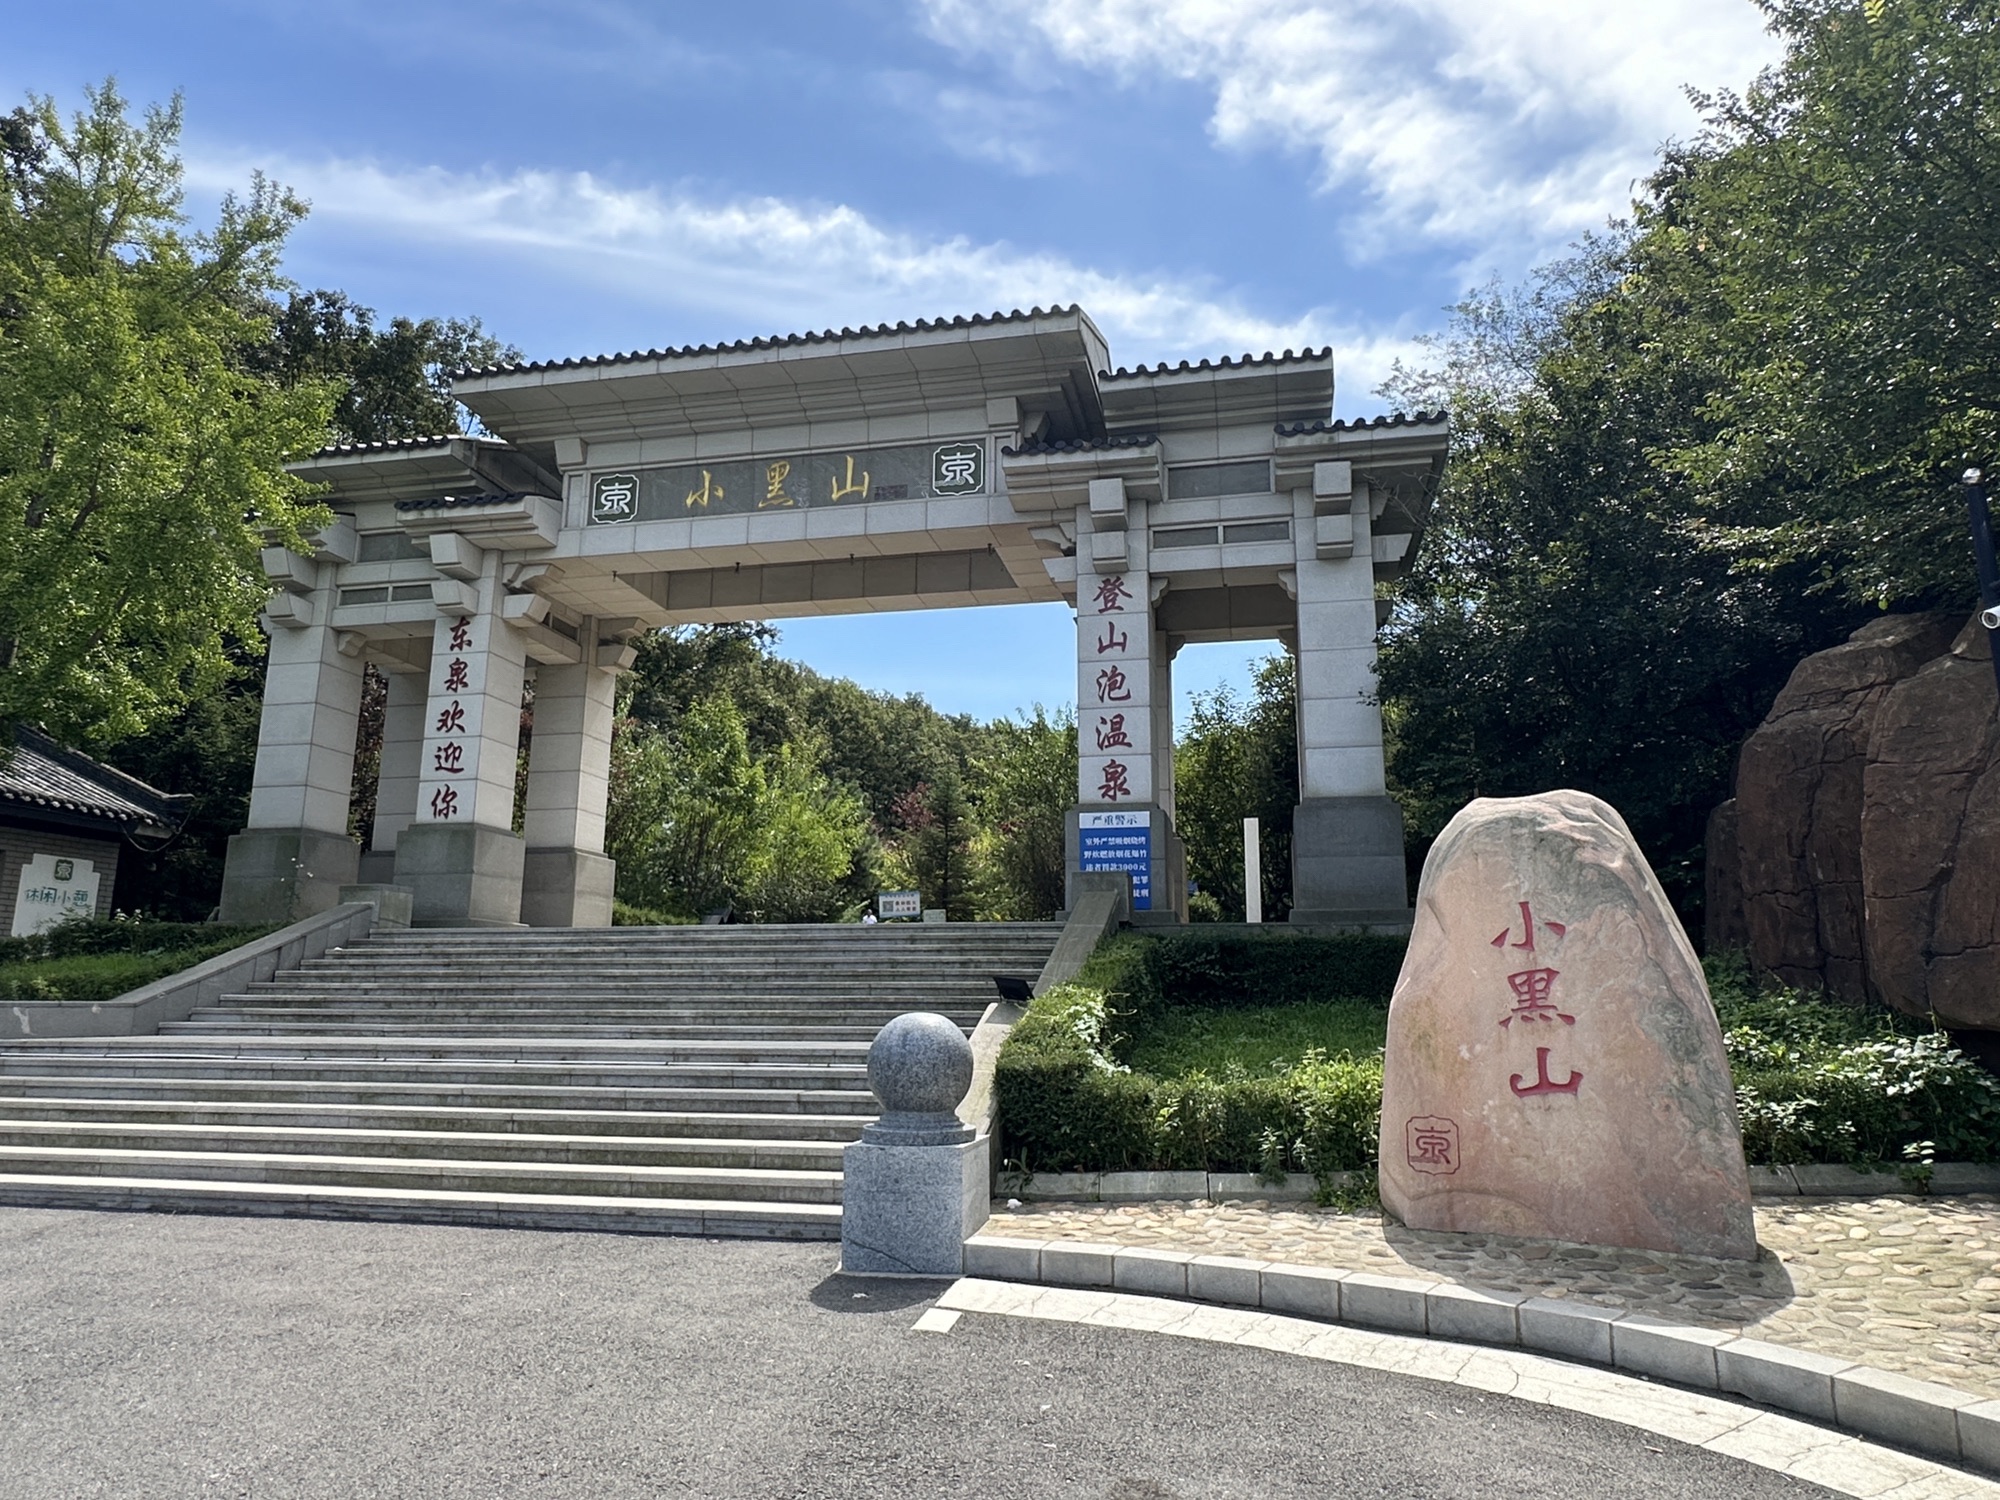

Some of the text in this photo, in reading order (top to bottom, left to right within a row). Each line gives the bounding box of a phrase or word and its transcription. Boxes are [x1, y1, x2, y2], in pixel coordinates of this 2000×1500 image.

[686, 455, 870, 508] 小黑山
[431, 616, 473, 820] 东泉欢迎你
[1093, 576, 1133, 801] 登山泡温泉
[1092, 815, 1138, 826] 严重警示
[25, 886, 89, 908] 休闲小憩
[1490, 901, 1584, 1098] 小黑山
